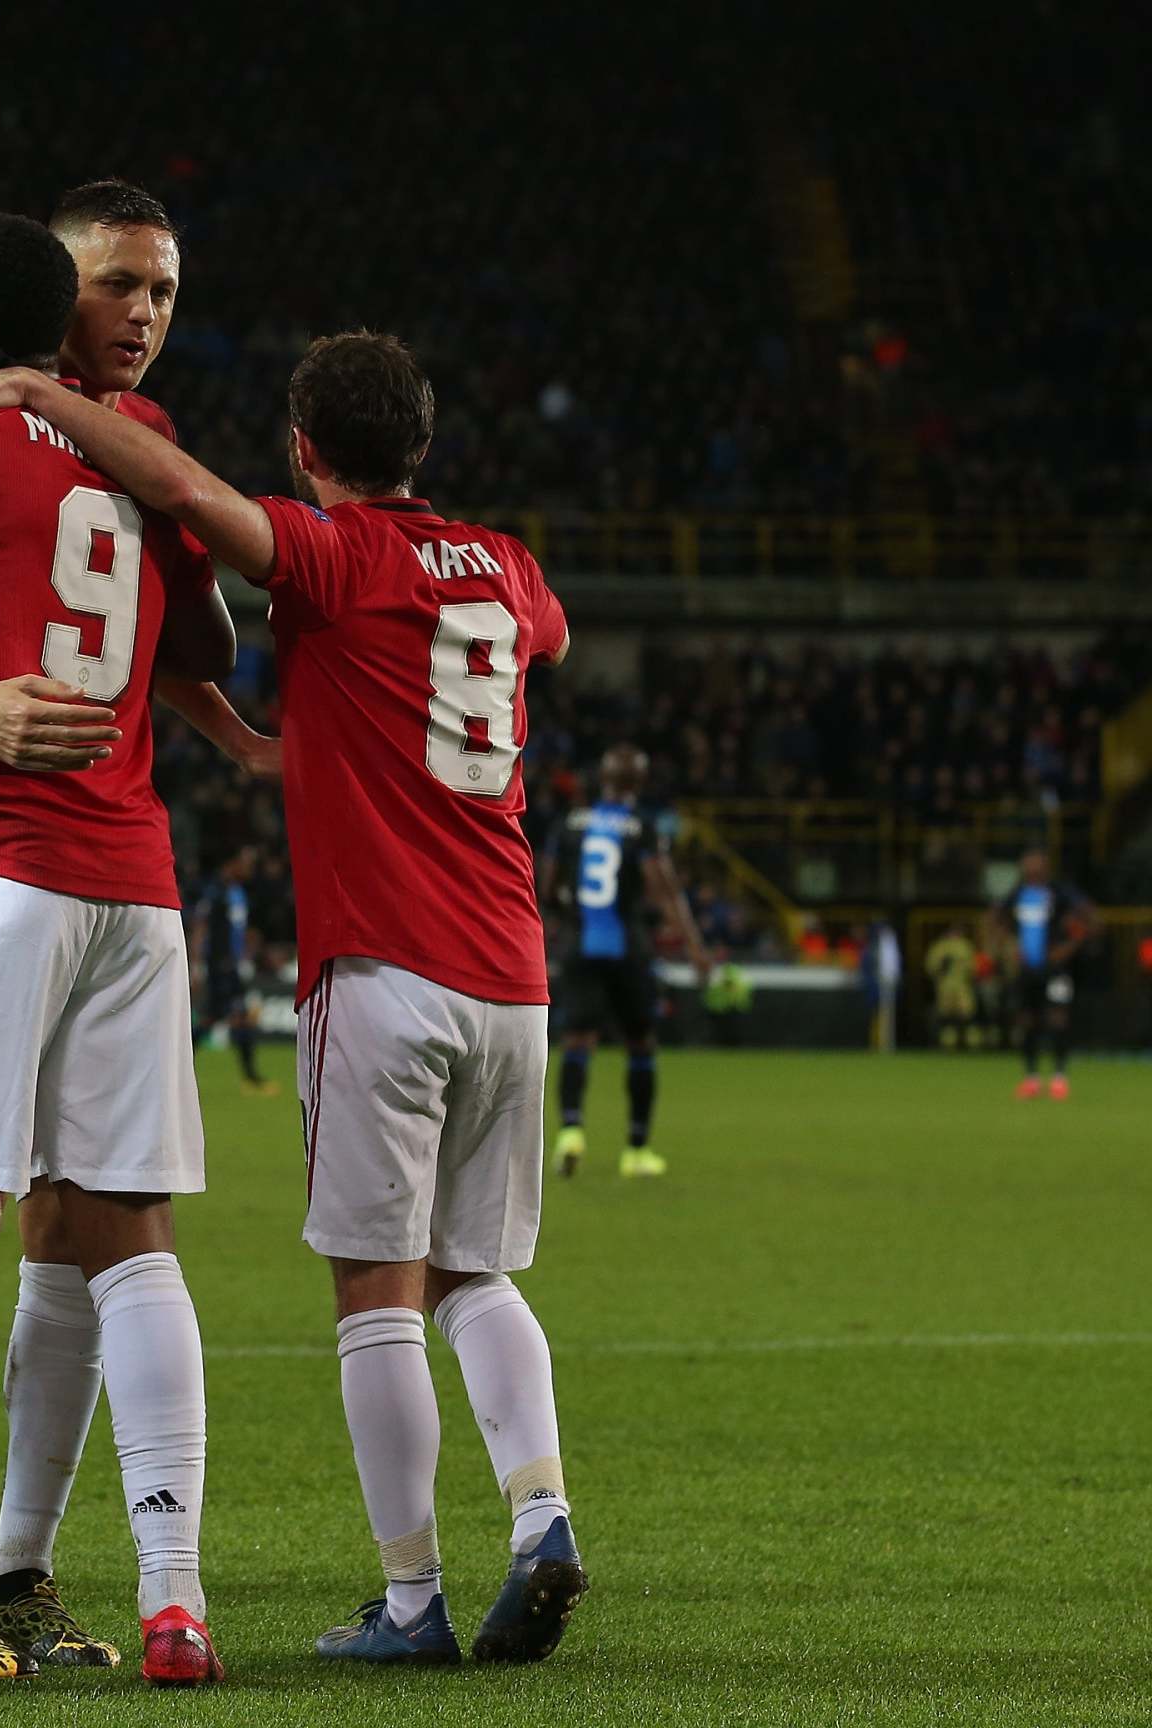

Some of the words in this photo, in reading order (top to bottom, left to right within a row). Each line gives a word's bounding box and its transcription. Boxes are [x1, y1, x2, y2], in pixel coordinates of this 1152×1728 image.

[41, 486, 143, 702] 9
[410, 539, 504, 580] MATA
[425, 601, 523, 796] 8
[578, 835, 622, 908] 3
[132, 1504, 186, 1514] adidas
